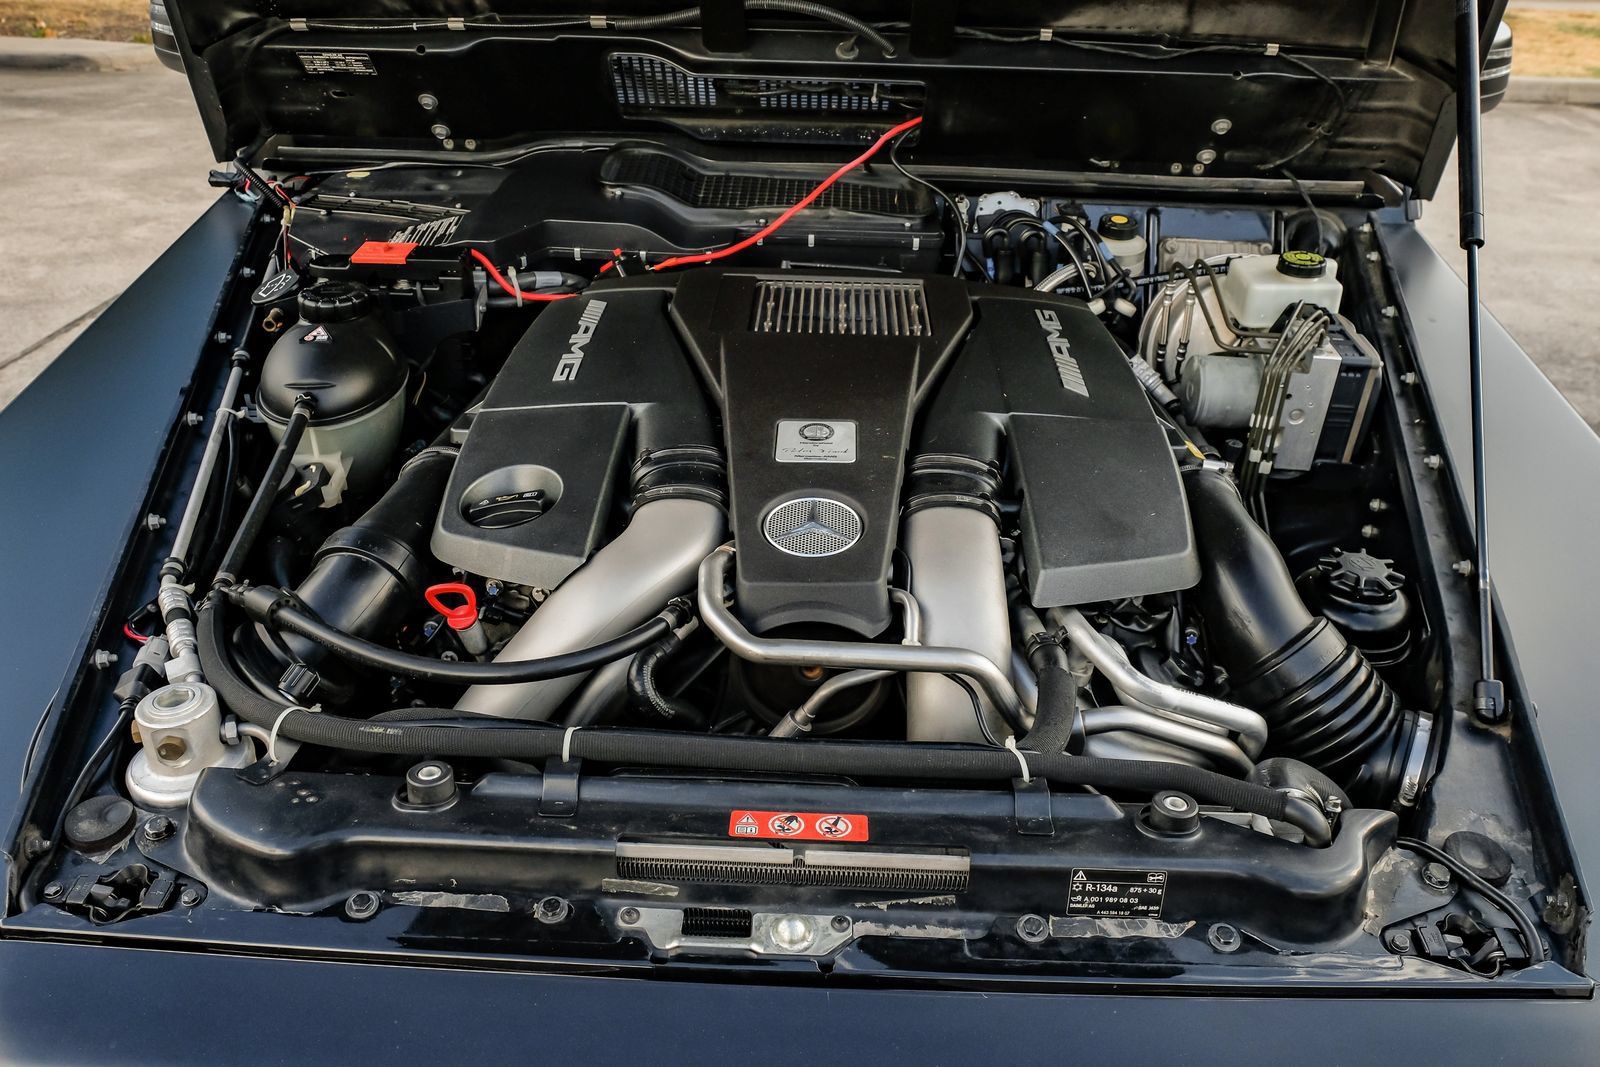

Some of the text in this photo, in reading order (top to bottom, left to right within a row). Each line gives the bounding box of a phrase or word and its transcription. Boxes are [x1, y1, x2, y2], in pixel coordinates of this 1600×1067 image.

[552, 319, 598, 381] AMG
[1035, 309, 1077, 365] AMG
[1085, 883, 1118, 893] R-134a
